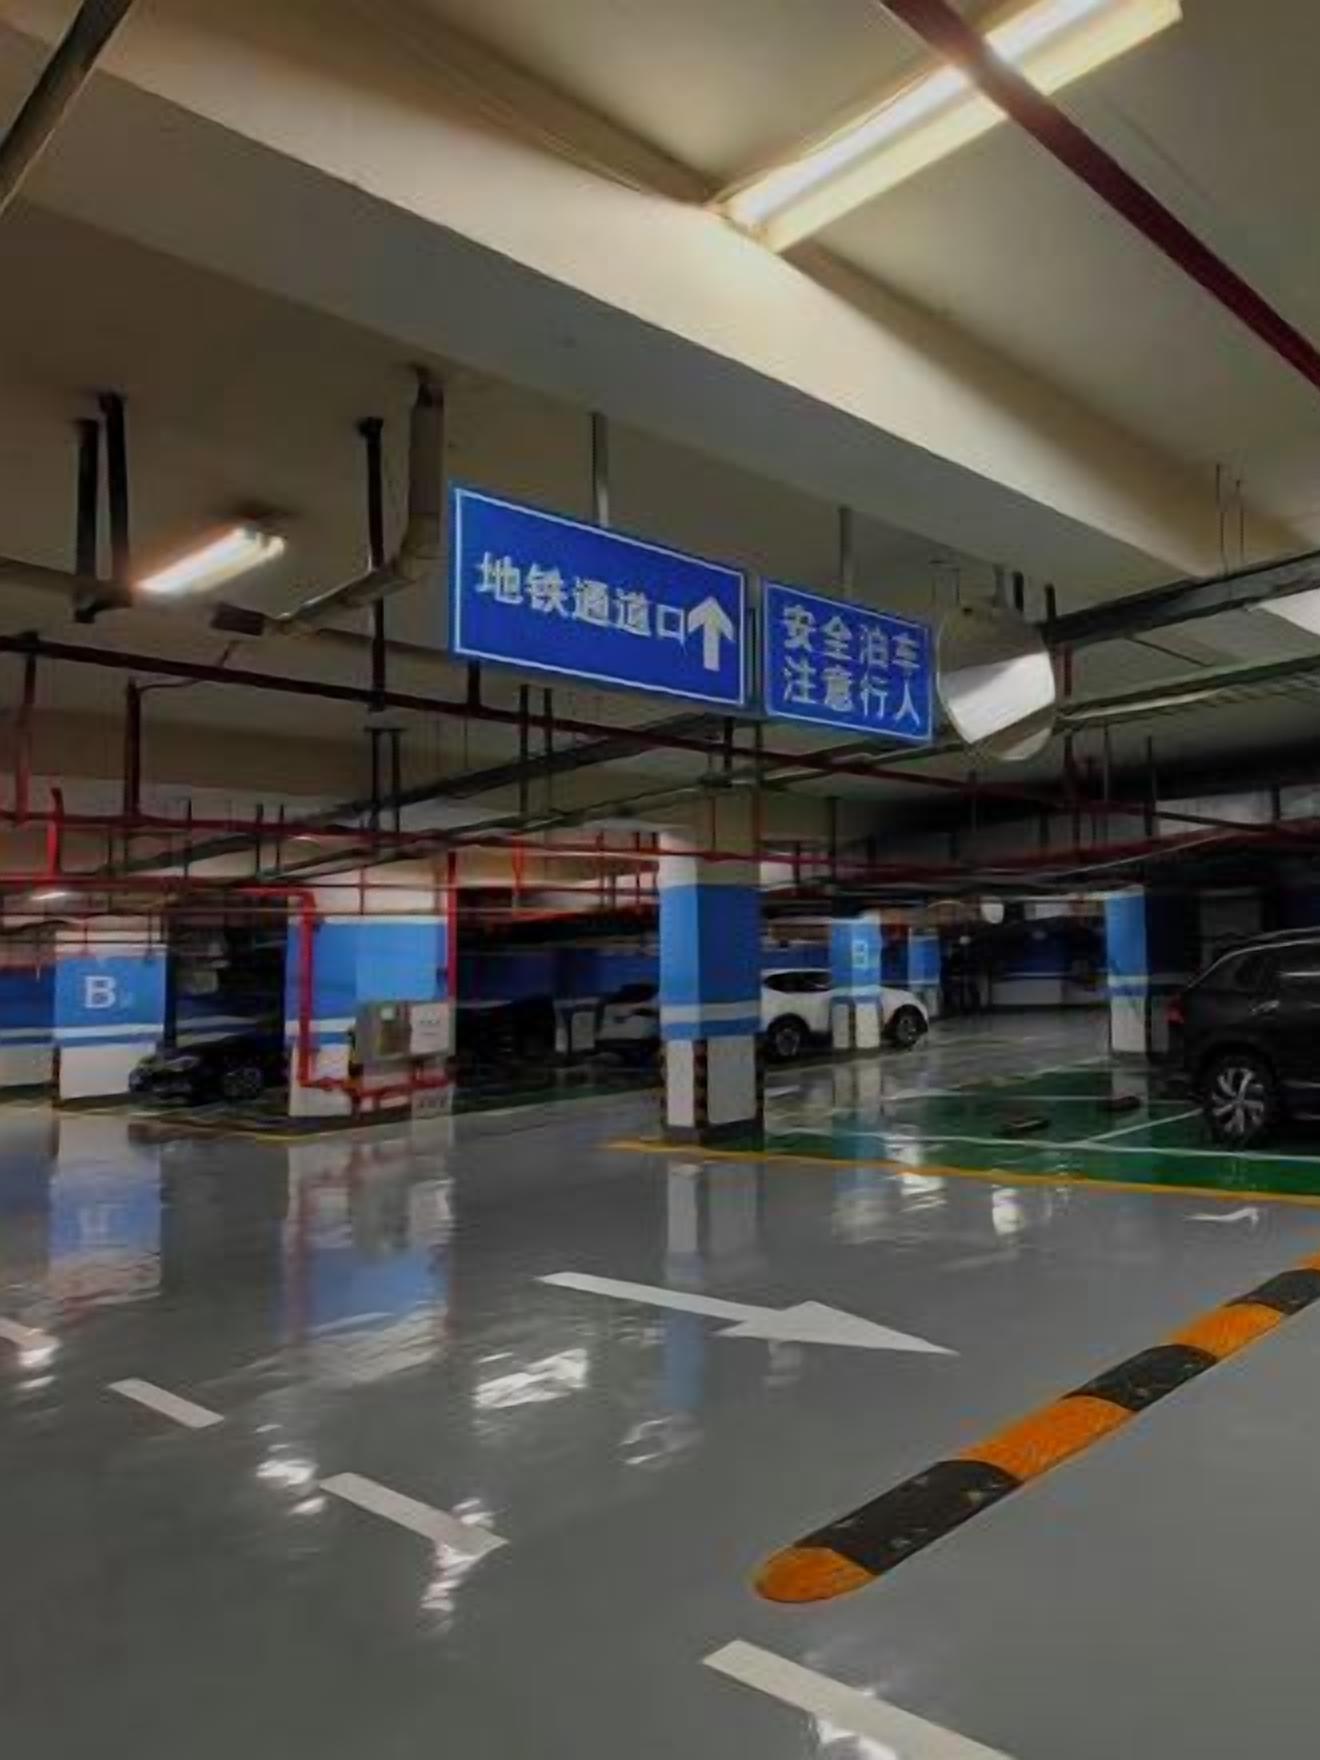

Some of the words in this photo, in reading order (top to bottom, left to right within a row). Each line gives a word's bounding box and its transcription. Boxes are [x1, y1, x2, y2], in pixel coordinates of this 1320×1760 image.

[475, 551, 685, 644] 地铁通道口
[782, 604, 920, 676] 安全泊车
[783, 655, 920, 728] 注意行人
